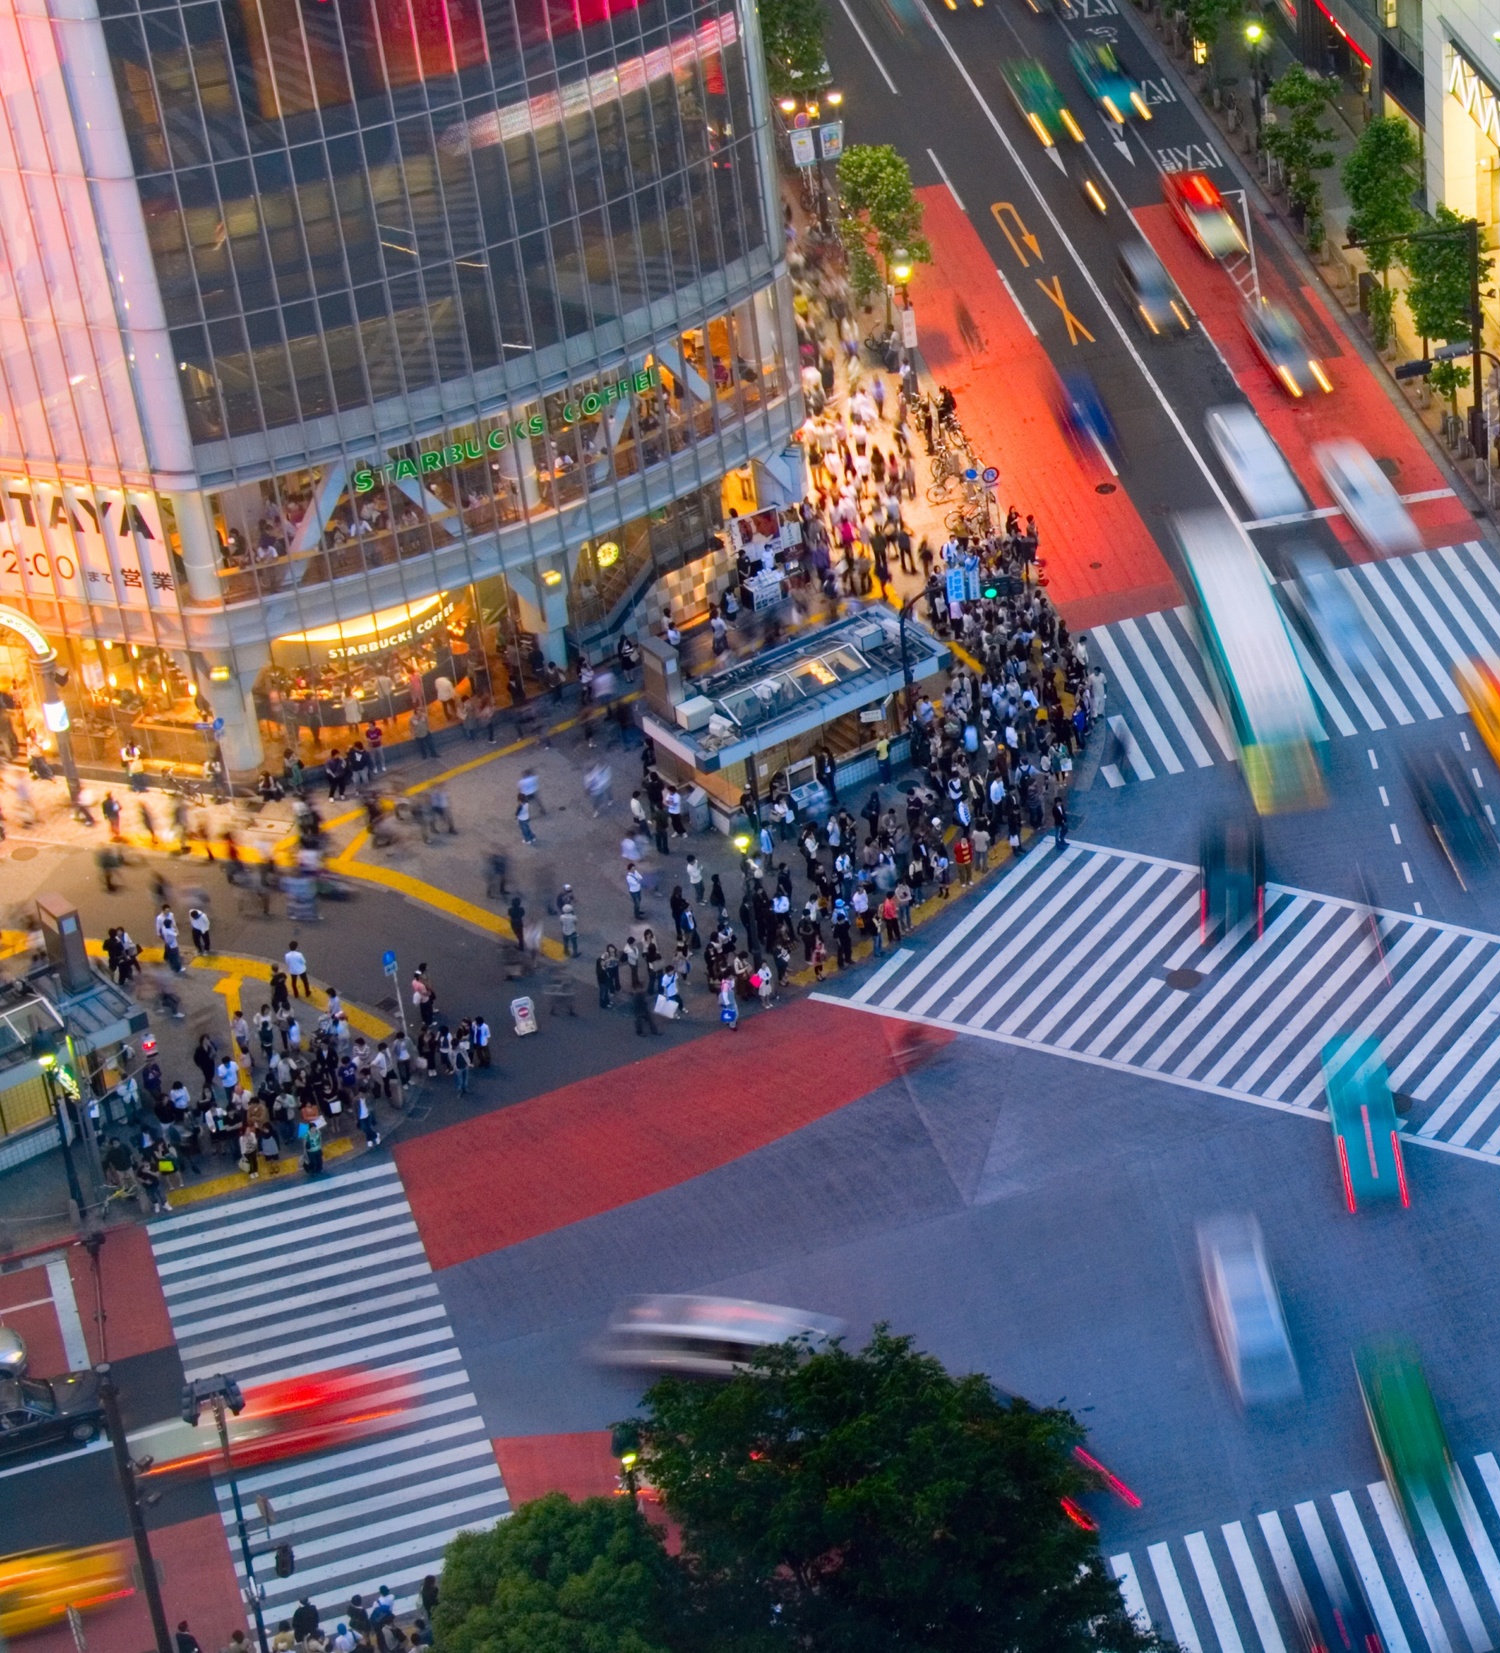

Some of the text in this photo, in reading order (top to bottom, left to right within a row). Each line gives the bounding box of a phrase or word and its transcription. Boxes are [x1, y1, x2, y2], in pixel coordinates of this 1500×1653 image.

[355, 413, 547, 494] STARBUCKS
[0, 490, 156, 540] TAYA
[328, 602, 455, 659] STARBUCKS COFFEE
